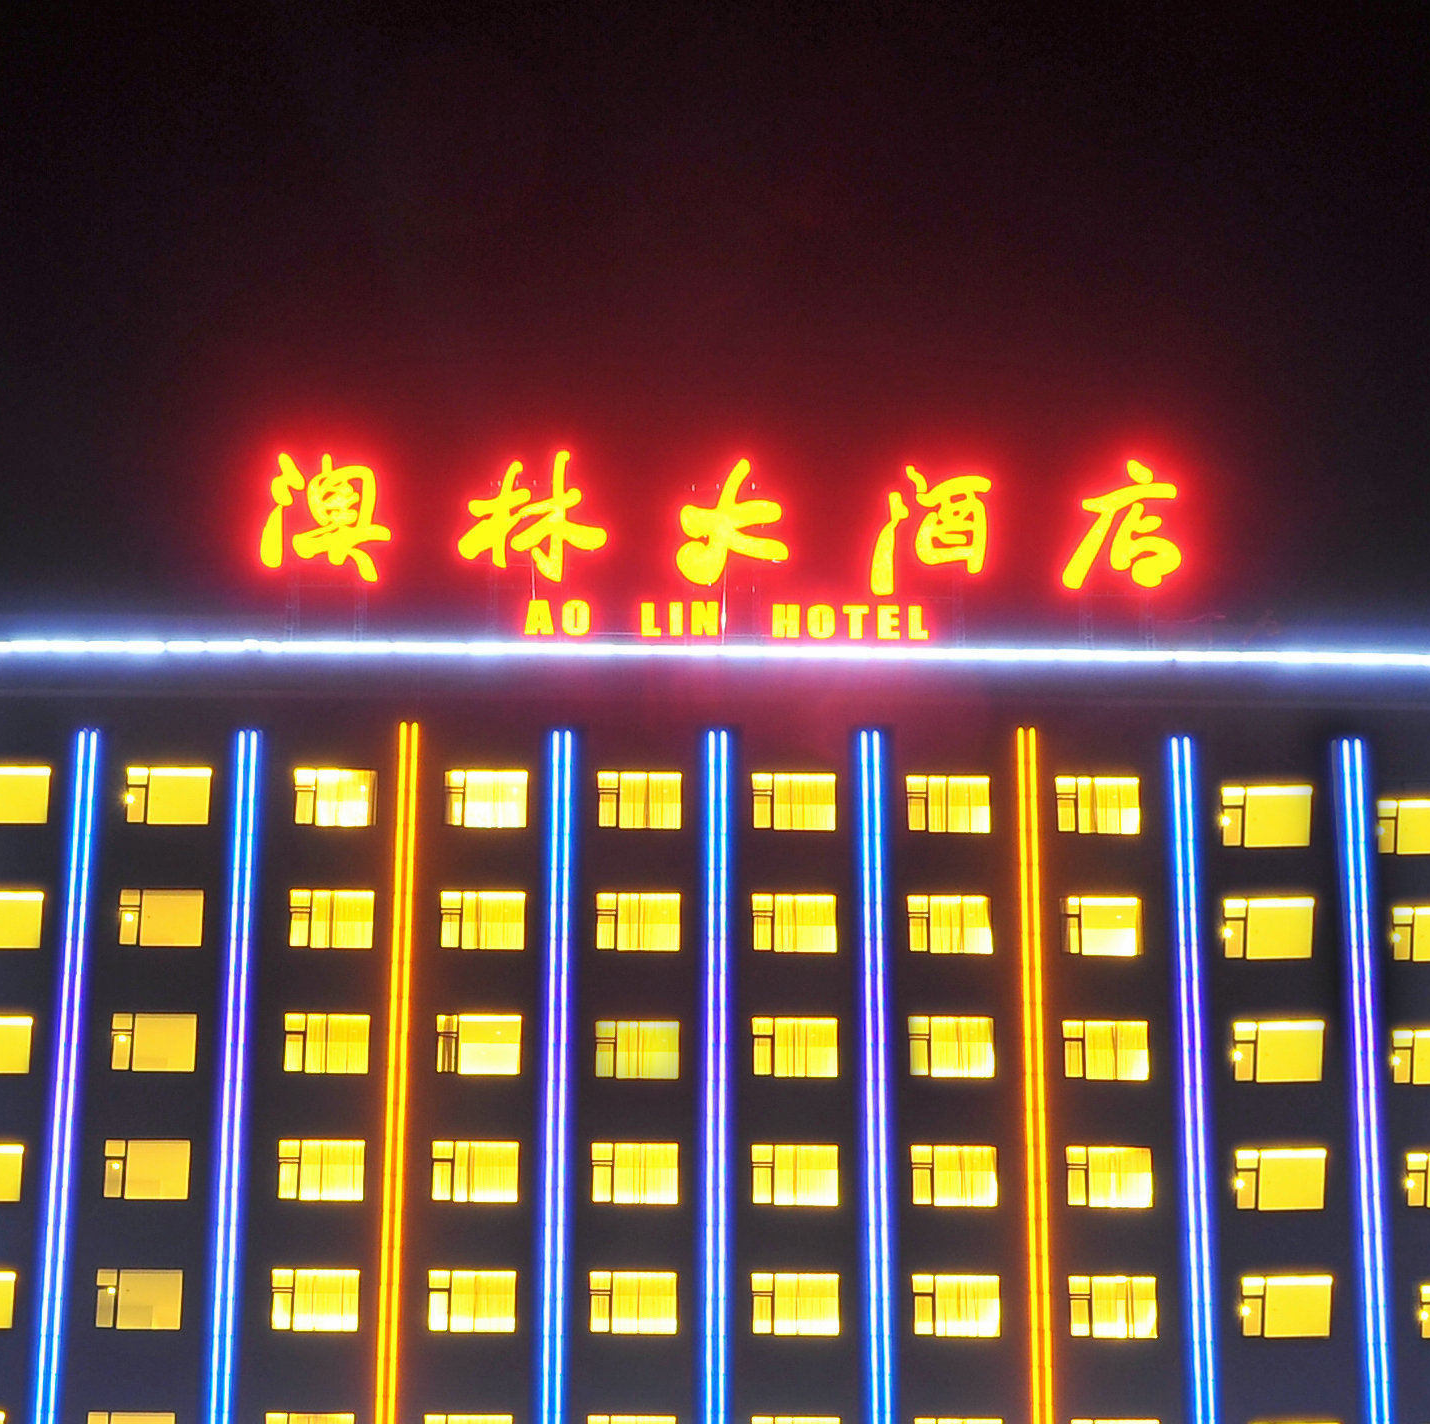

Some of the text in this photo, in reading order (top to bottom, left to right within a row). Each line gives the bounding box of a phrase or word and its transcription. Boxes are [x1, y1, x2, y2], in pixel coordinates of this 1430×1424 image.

[258, 449, 1184, 597] 澳林大酒店
[523, 598, 930, 641] AO LIN HOTEL
